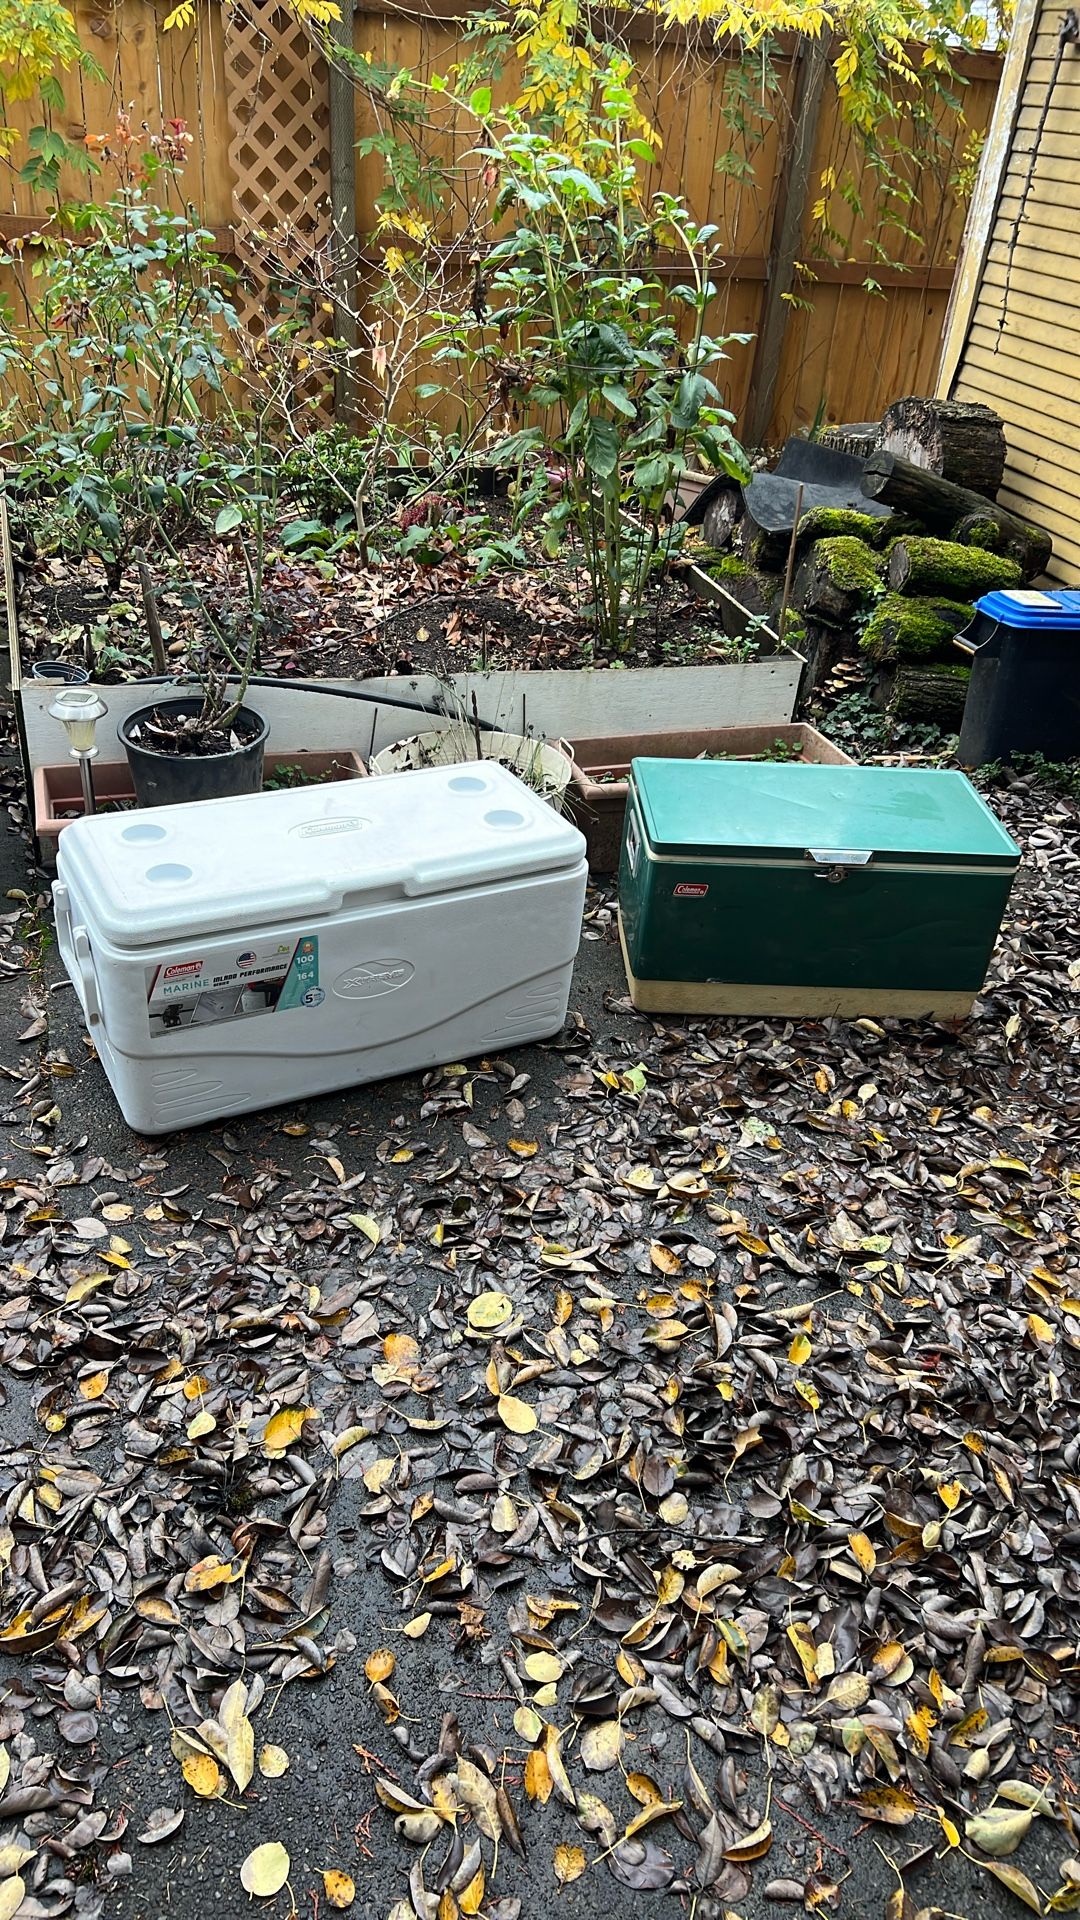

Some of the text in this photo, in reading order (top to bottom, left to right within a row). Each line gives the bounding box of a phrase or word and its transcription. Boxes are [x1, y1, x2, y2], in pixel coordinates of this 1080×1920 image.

[677, 885, 701, 894] Coleman
[296, 955, 314, 964] 100
[166, 963, 195, 976] Coleman
[240, 963, 288, 978] PERFORMANCE
[297, 971, 314, 980] 164
[164, 979, 209, 994] MARINE
[305, 994, 313, 1003] 5
